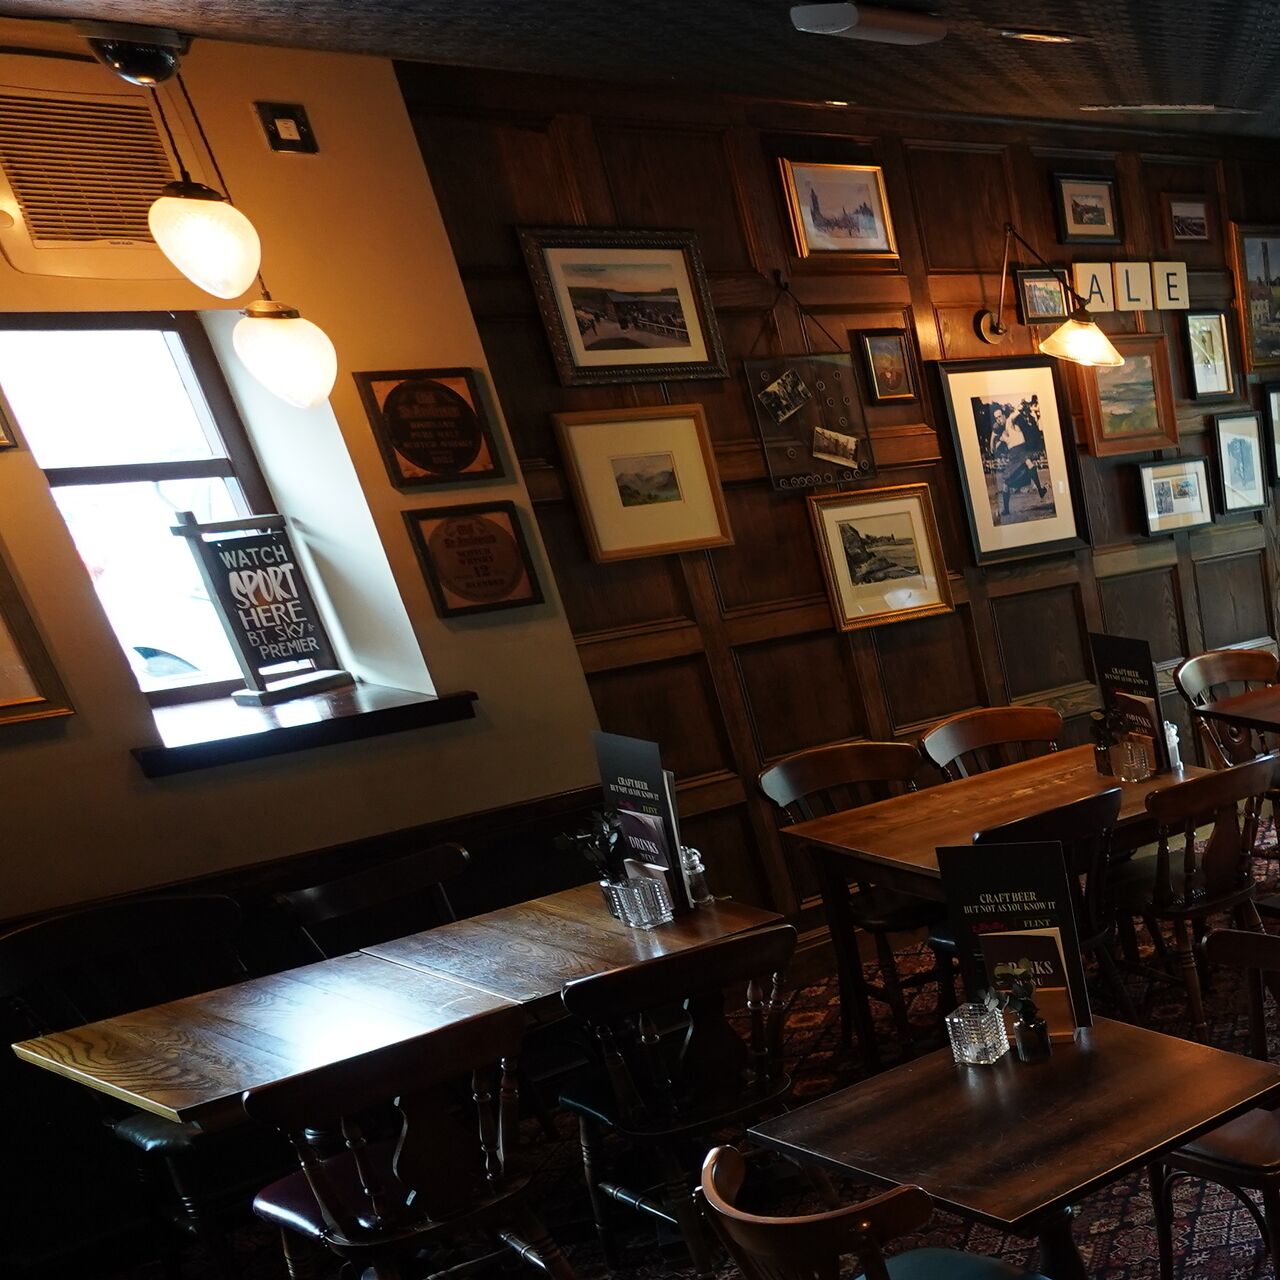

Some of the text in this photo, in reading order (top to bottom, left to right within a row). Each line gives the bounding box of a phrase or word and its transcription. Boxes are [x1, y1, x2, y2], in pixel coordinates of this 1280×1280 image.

[1089, 269, 1180, 304] ALE
[219, 544, 289, 569] WATCH
[229, 562, 299, 610] SPORT
[237, 600, 307, 631] HERE
[275, 622, 305, 641] SKY
[259, 636, 320, 660] PREMIER
[963, 904, 980, 915] BUT
[980, 904, 996, 914] NOT
[1023, 901, 1047, 913] KNOW
[1048, 901, 1057, 910] IT
[979, 890, 1038, 904] CRAFT BEER
[1023, 918, 1051, 929] FLINT
